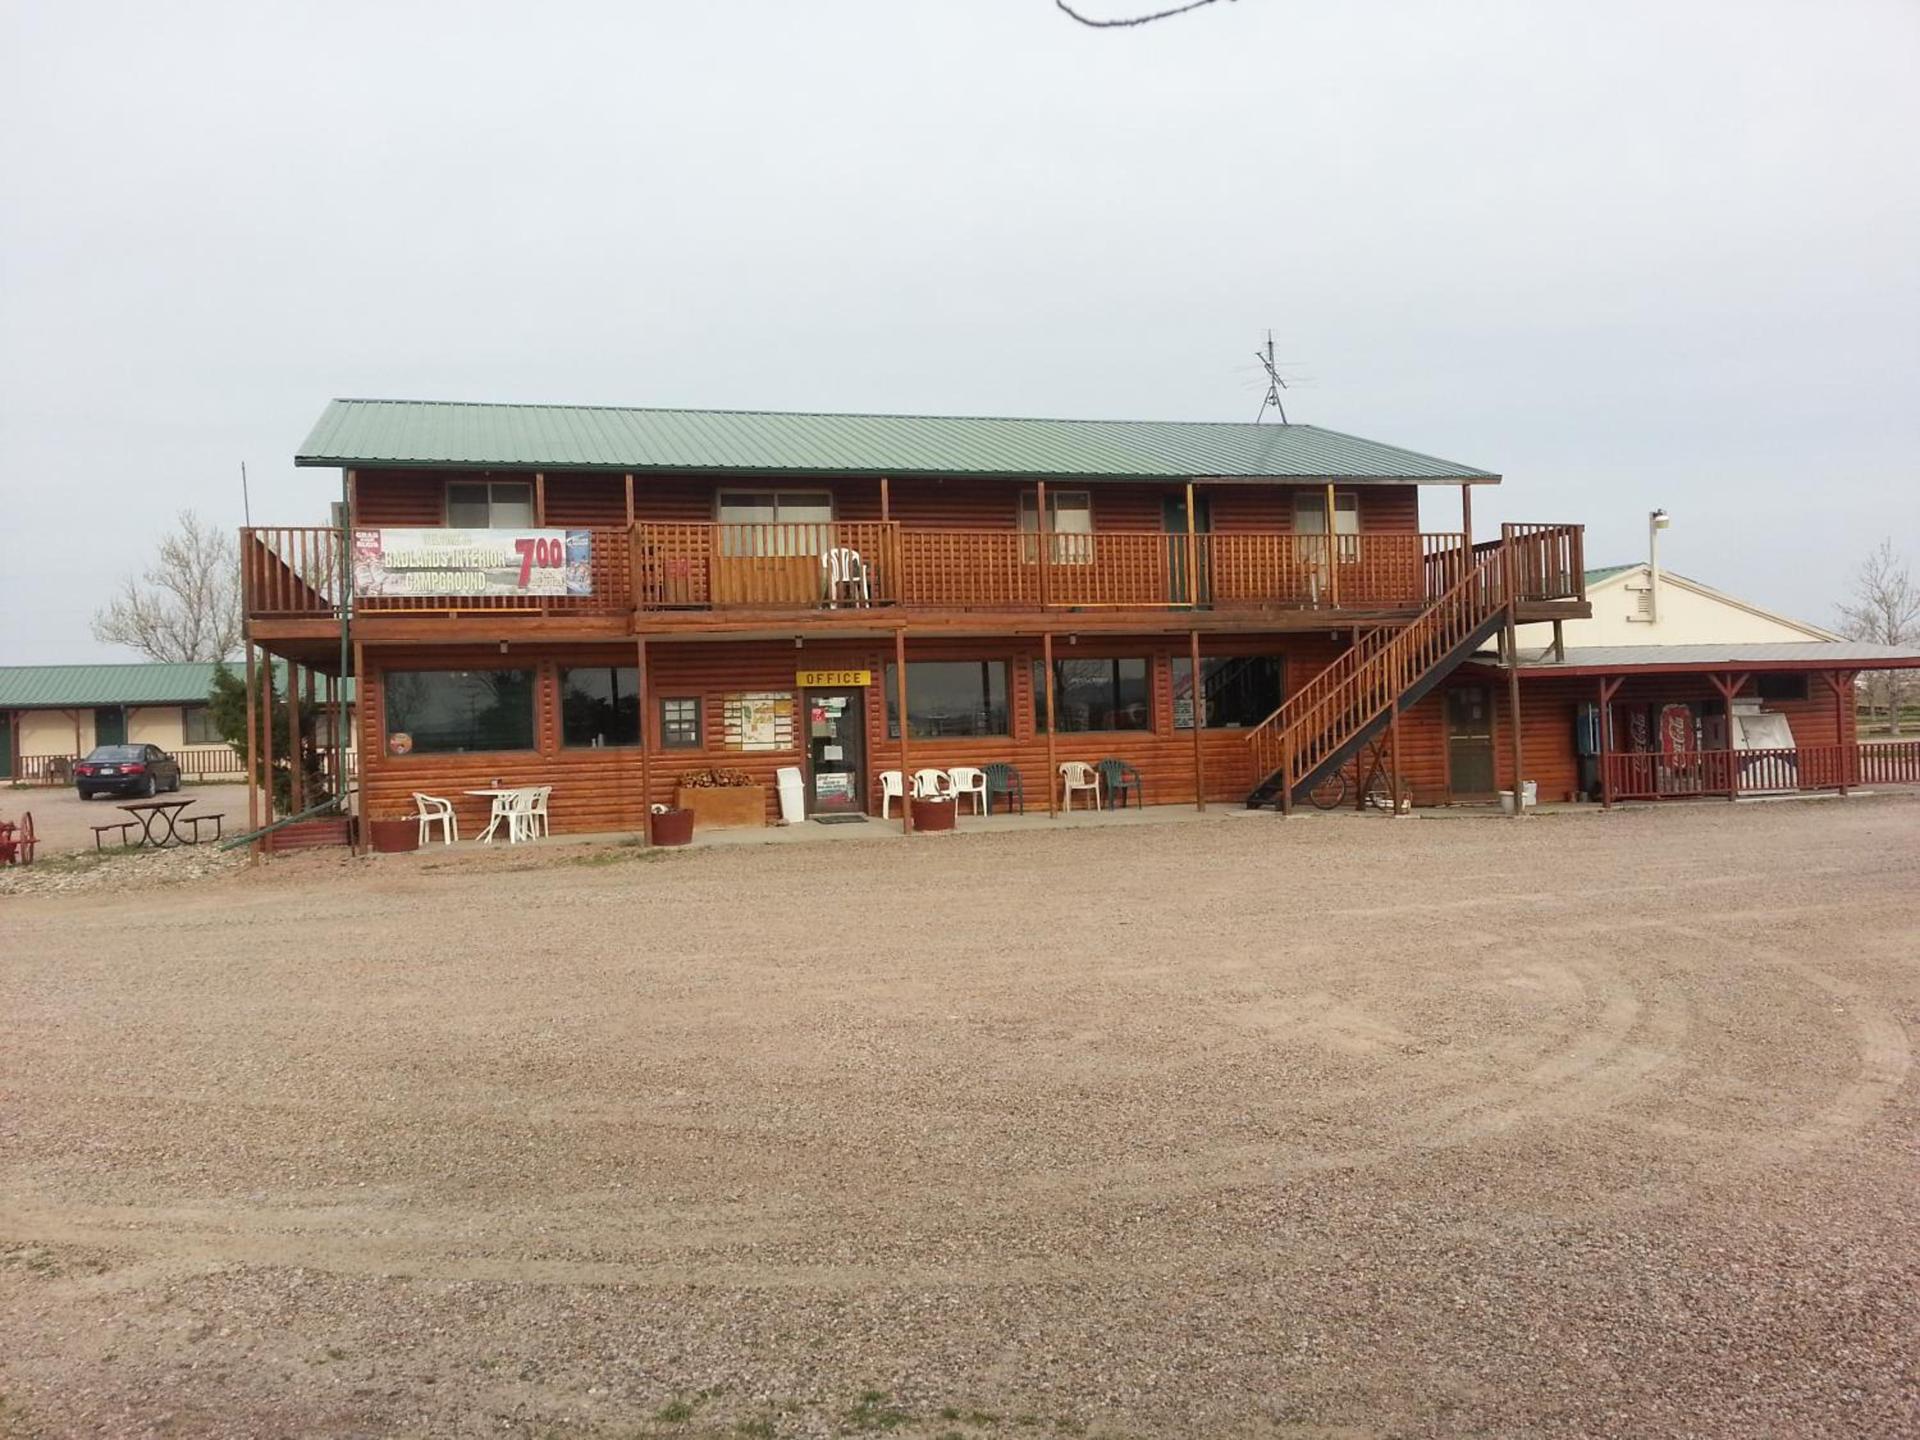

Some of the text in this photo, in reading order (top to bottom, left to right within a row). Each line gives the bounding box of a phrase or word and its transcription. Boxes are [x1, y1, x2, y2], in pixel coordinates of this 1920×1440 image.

[385, 549, 506, 568] BADLANDS INTERIOR
[405, 571, 486, 592] CAMPGROUND
[806, 673, 861, 684] OFFICE
